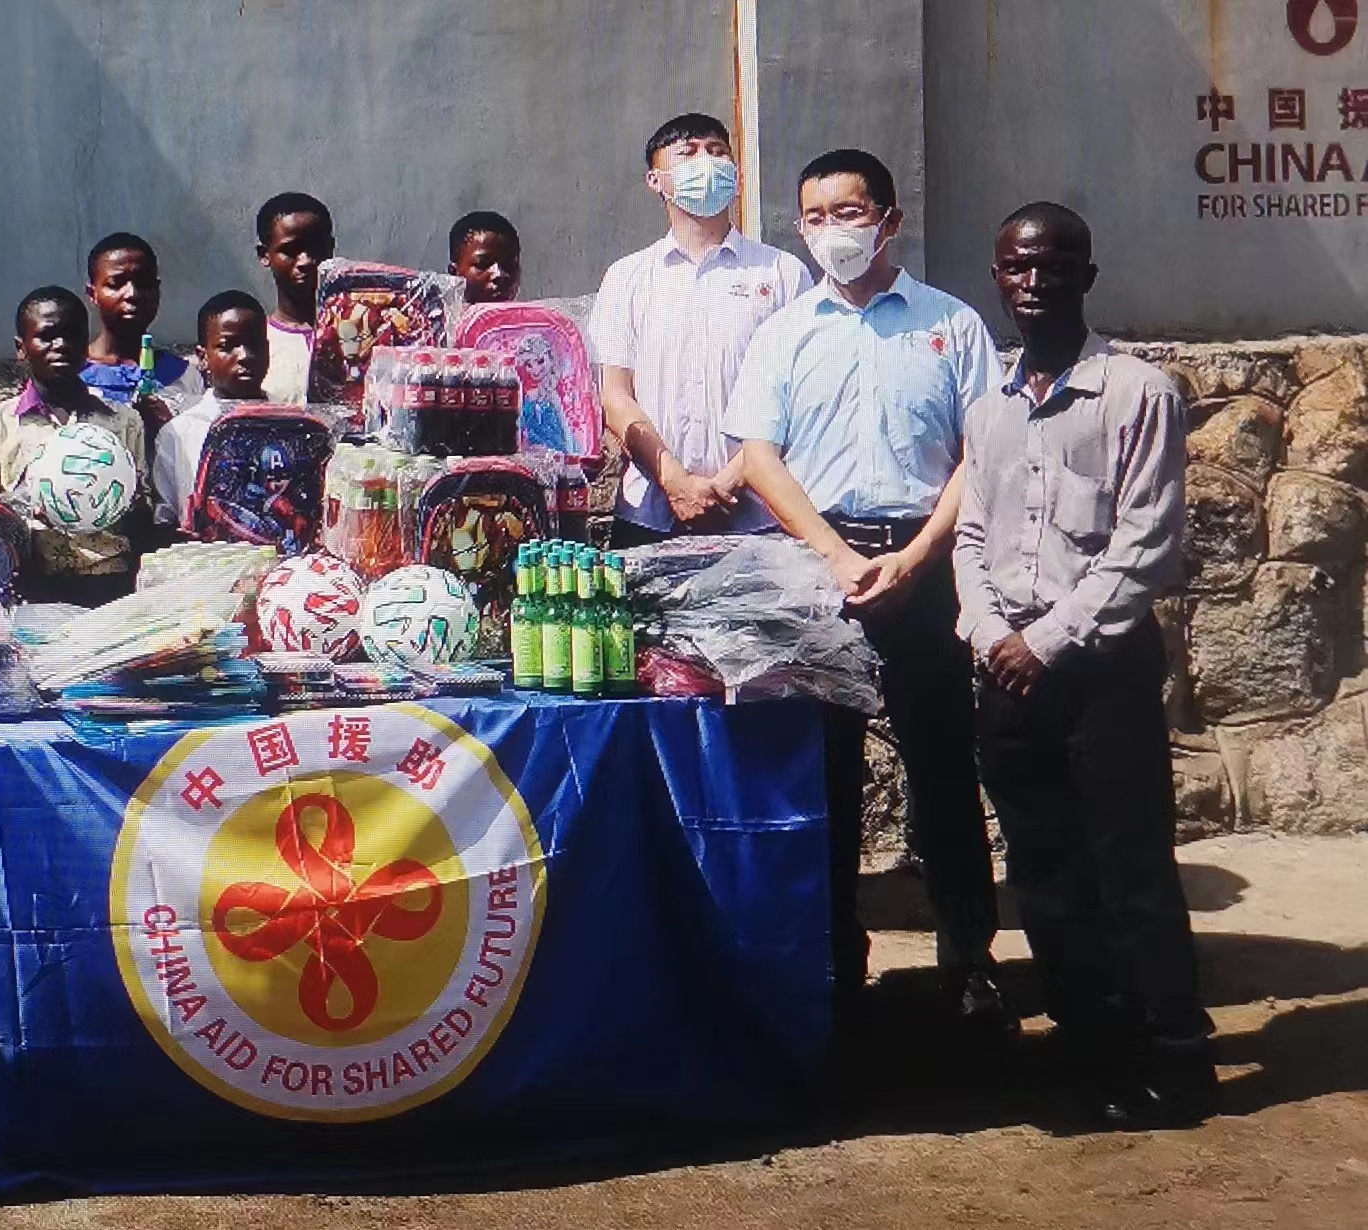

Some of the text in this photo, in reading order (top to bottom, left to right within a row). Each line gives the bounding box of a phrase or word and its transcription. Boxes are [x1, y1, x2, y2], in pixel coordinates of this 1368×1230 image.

[1195, 142, 1354, 184] CHINA
[1197, 194, 1248, 218] FOR
[1252, 193, 1350, 218] SHARED
[179, 714, 447, 812] 中国援助
[143, 863, 518, 1097] CHINA AID FOR SHARED FUTURE
